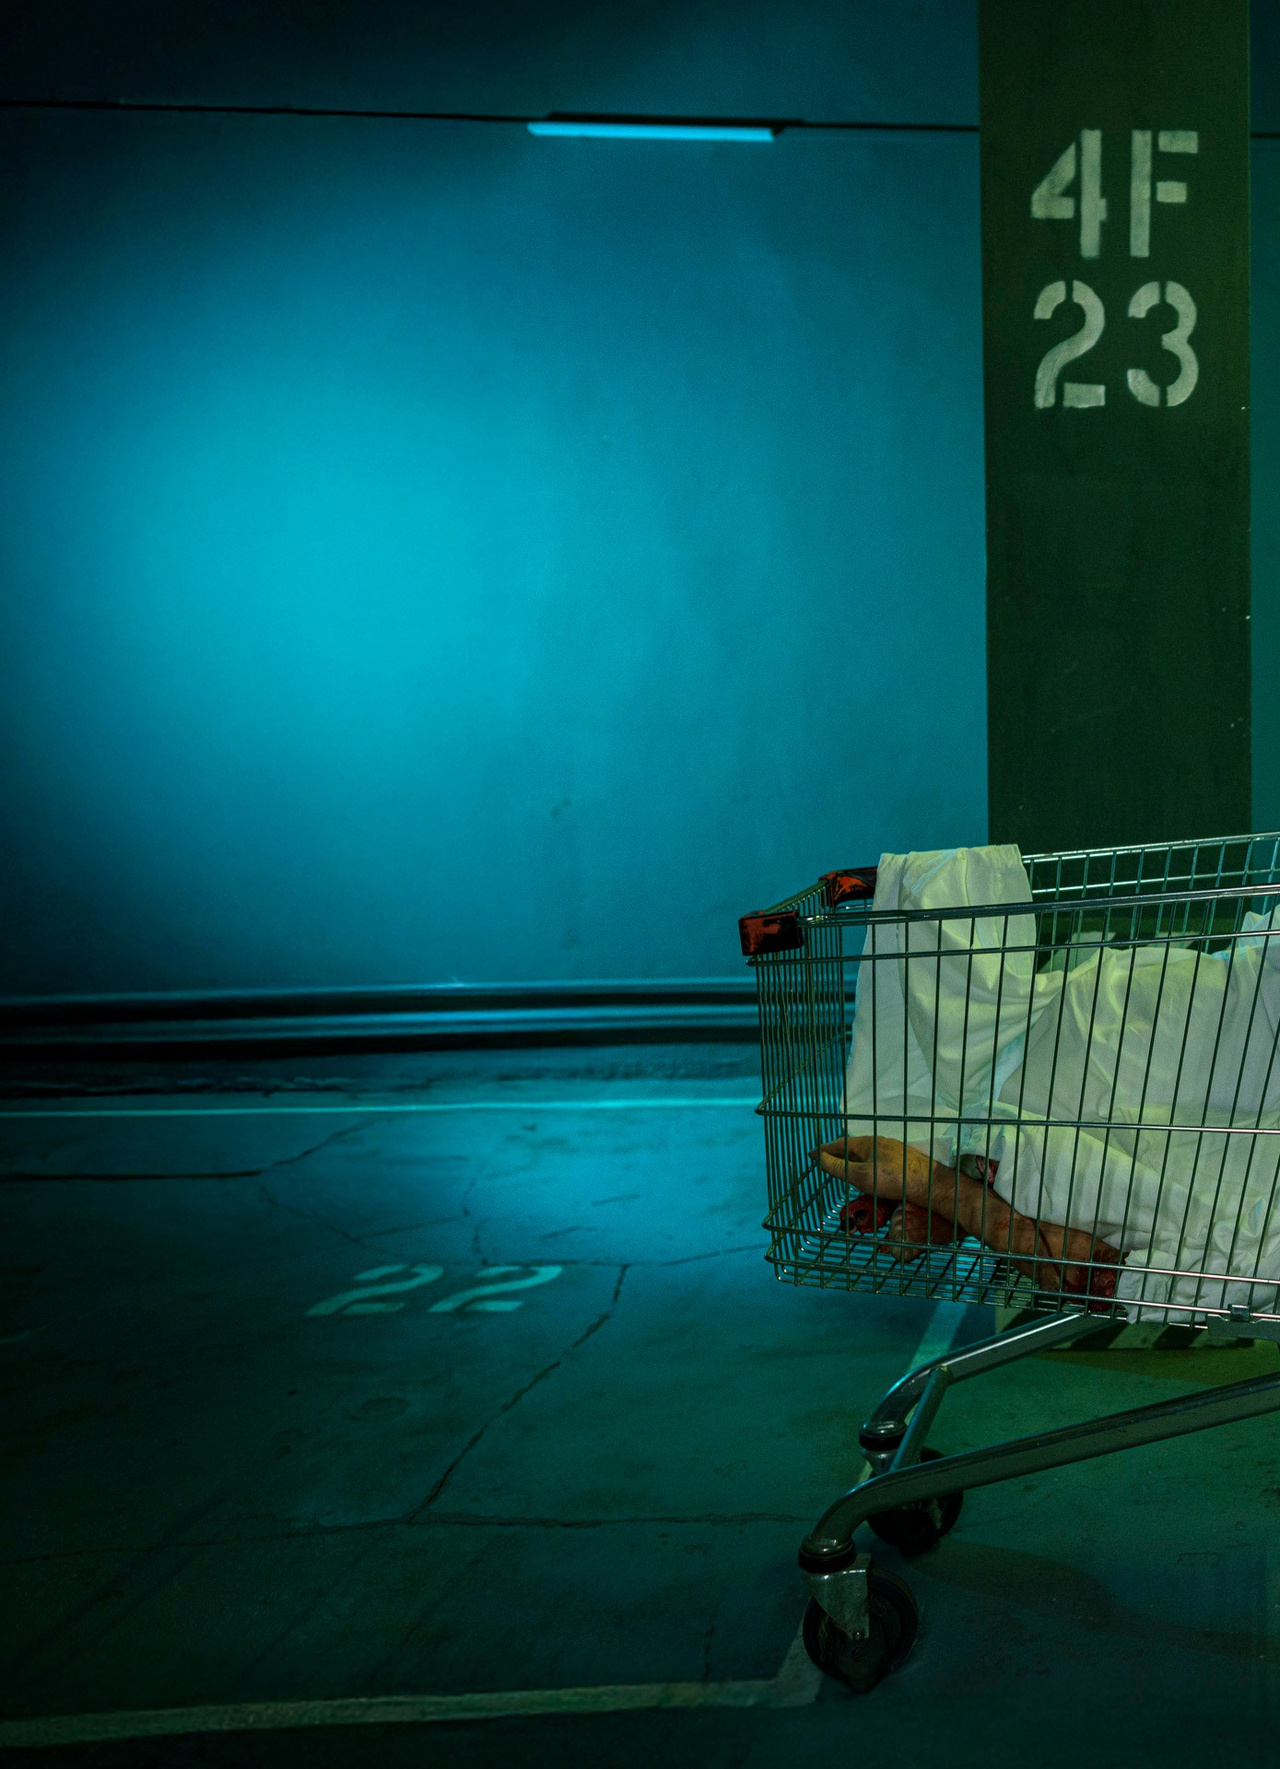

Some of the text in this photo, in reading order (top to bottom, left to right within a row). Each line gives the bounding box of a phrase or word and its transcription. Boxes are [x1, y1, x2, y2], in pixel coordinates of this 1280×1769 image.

[1031, 128, 1199, 258] 4F
[1033, 280, 1200, 409] 23
[305, 1263, 564, 1317] 22
